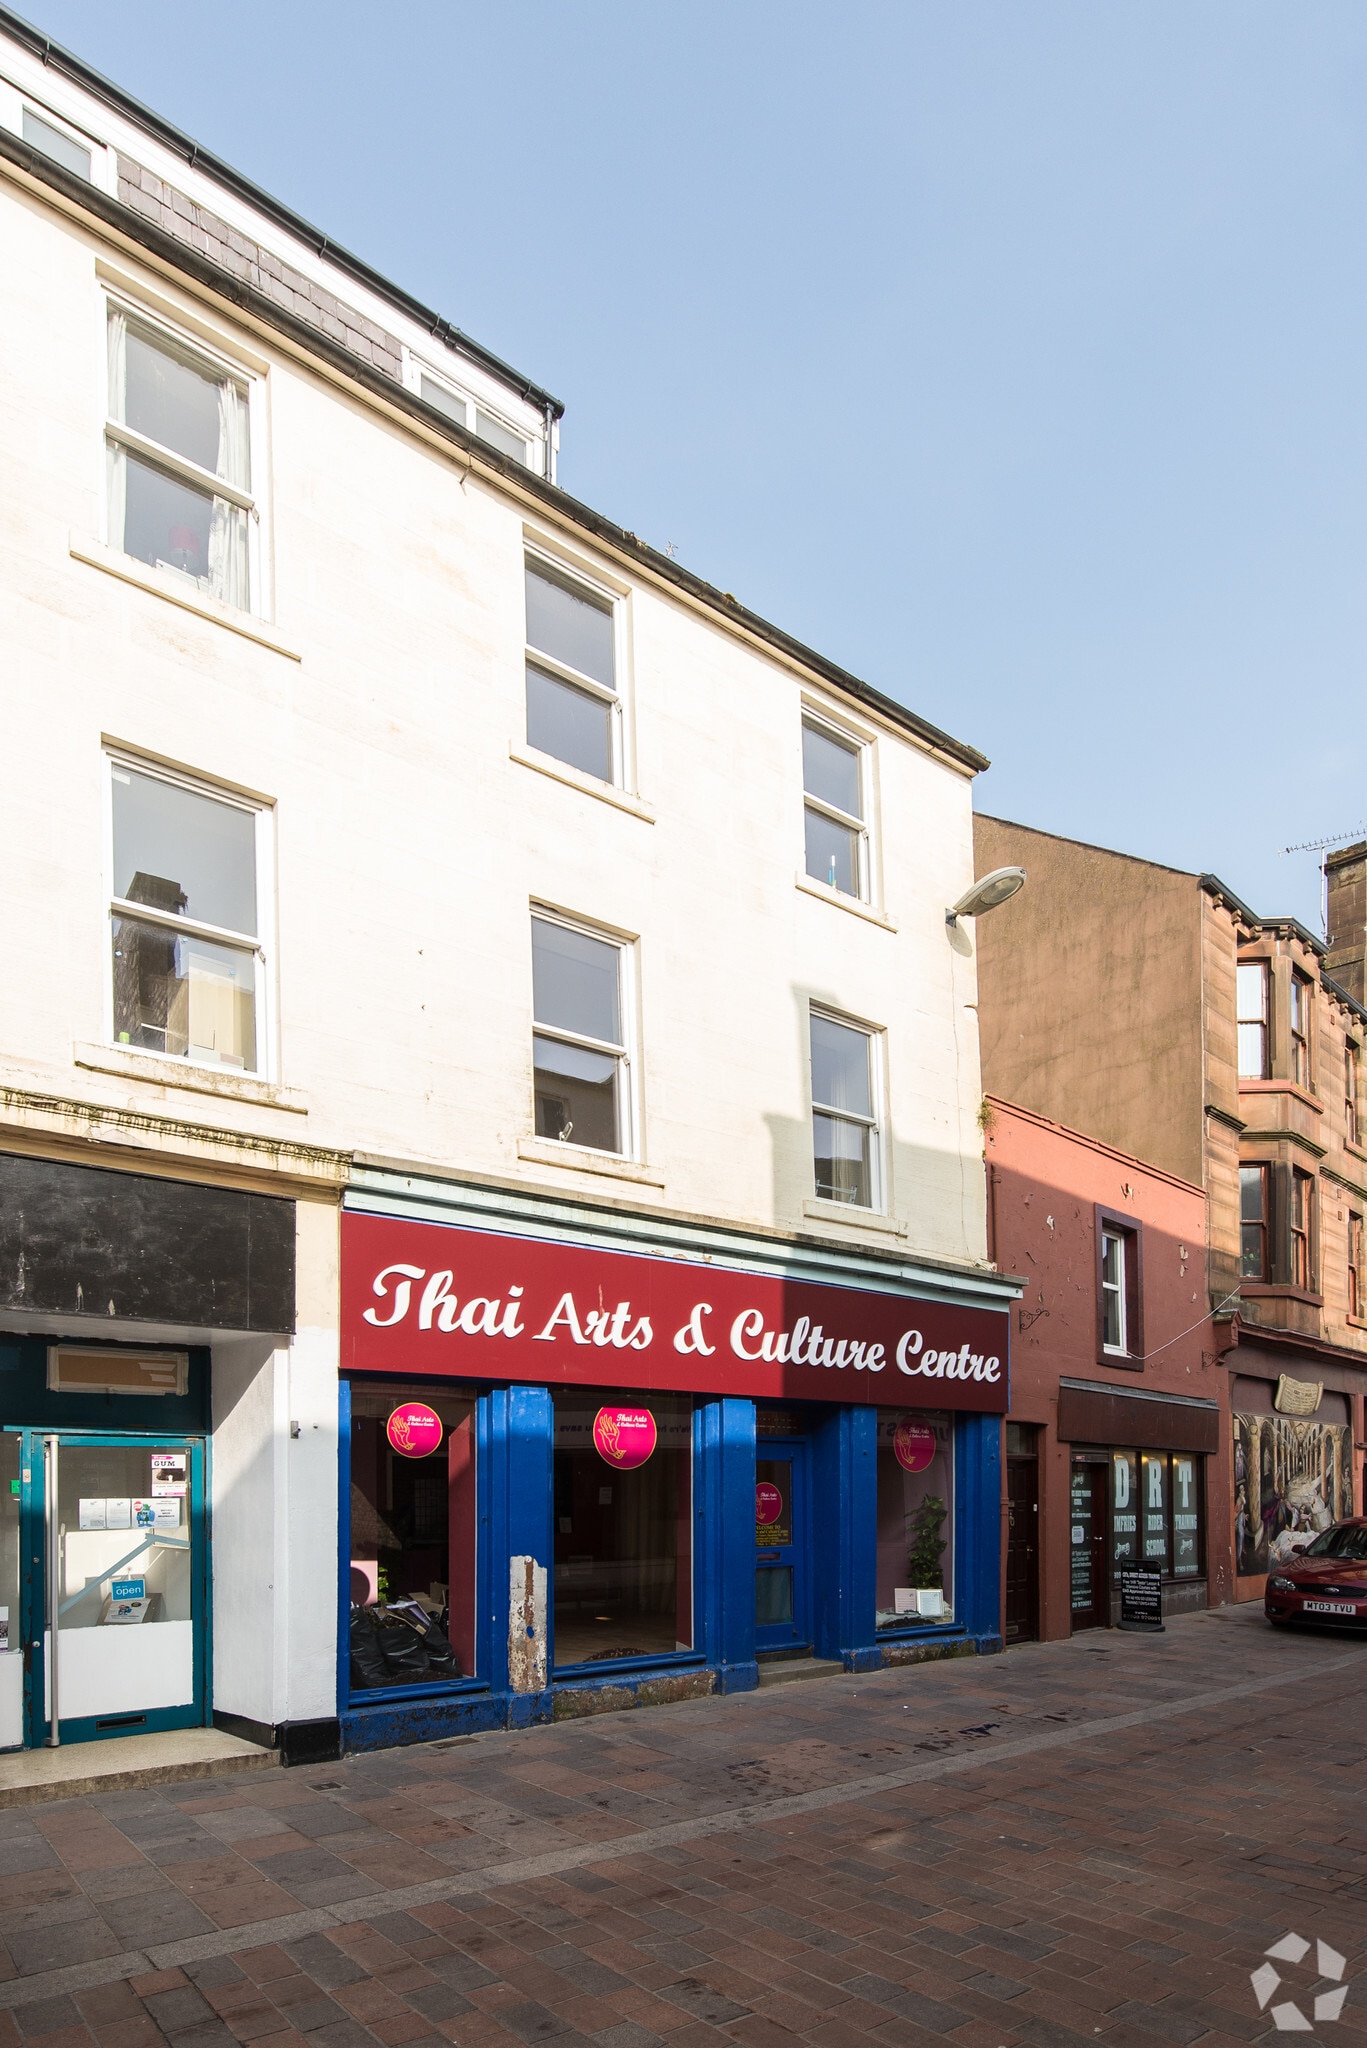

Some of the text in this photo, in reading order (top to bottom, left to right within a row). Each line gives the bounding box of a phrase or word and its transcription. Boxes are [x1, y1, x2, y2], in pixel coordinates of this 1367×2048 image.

[362, 1263, 1001, 1383] Thai Arts & Culture Centre
[617, 1413, 647, 1423] Thai Arts
[1115, 1458, 1192, 1509] D R T
[1147, 1514, 1164, 1531] RIDER
[1175, 1514, 1198, 1530] TRAINING
[1146, 1539, 1166, 1557] SCHOOL
[116, 1587, 141, 1596] open
[1307, 1602, 1352, 1613] MT03 TVU
